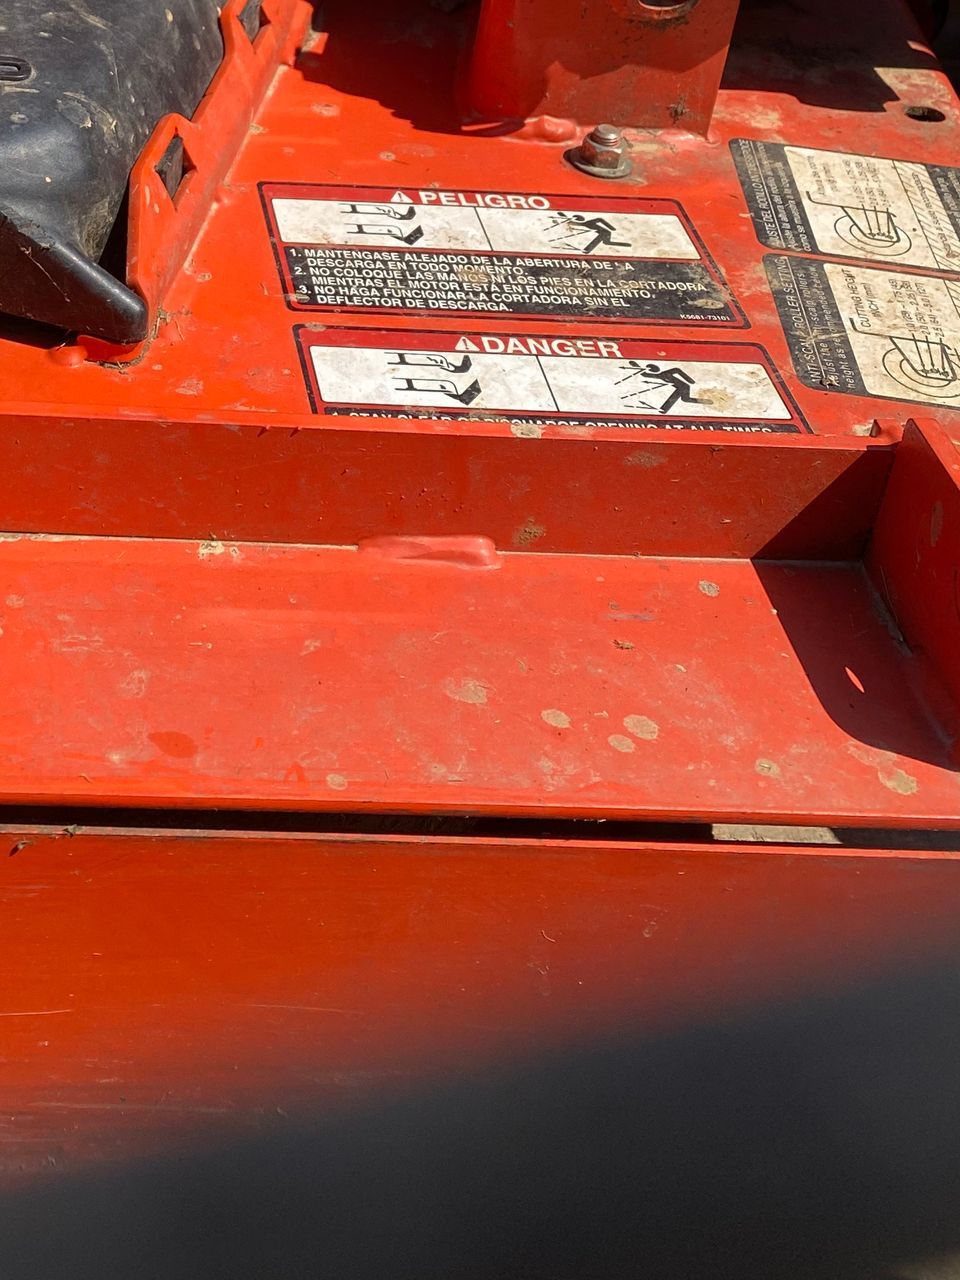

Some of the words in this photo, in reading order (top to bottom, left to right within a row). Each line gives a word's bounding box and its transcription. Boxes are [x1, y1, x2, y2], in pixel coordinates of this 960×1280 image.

[419, 190, 552, 209] PELIGRO
[798, 233, 812, 251] como
[289, 248, 302, 258] 1.
[304, 249, 400, 263] MANTENGASE
[404, 253, 468, 265] ALEJADO
[471, 256, 492, 266] DE
[494, 257, 513, 266] LA
[514, 257, 590, 270] ABERTURA
[593, 261, 614, 271] DE
[306, 258, 387, 270] DESCARGA
[390, 261, 408, 270] EN
[411, 262, 450, 272] TODO
[452, 265, 528, 277] MOMENTO.
[294, 267, 307, 276] 2.
[309, 268, 331, 277] NO
[333, 269, 403, 281] COLOQUE
[408, 272, 434, 282] LAS
[437, 273, 489, 284] MANOS
[493, 276, 508, 285] NI
[512, 277, 539, 286] LOS
[574, 279, 594, 289] EN
[596, 280, 616, 290] LA
[618, 281, 707, 293] CORTADORA
[311, 277, 384, 289] MIENTRAS
[390, 280, 406, 290] EL
[409, 281, 460, 292] MOTOR
[505, 285, 525, 294] EN
[775, 257, 793, 293] SETTING
[314, 286, 336, 296] NO
[339, 287, 380, 298] HAGA
[384, 289, 461, 301] FUNCIONAR
[469, 293, 491, 302] LA
[494, 294, 582, 306] CORTADORA
[585, 298, 609, 307] SIN
[611, 299, 630, 308] EL
[316, 295, 404, 308] DEFLECTOR
[407, 299, 427, 309] DE
[429, 300, 513, 312] DESCARGA.
[787, 294, 804, 328] ROLLER
[850, 295, 872, 327] CUTTING
[480, 336, 625, 357] DANGER
[817, 342, 830, 356] the
[834, 347, 846, 358] as
[841, 360, 856, 389] height
